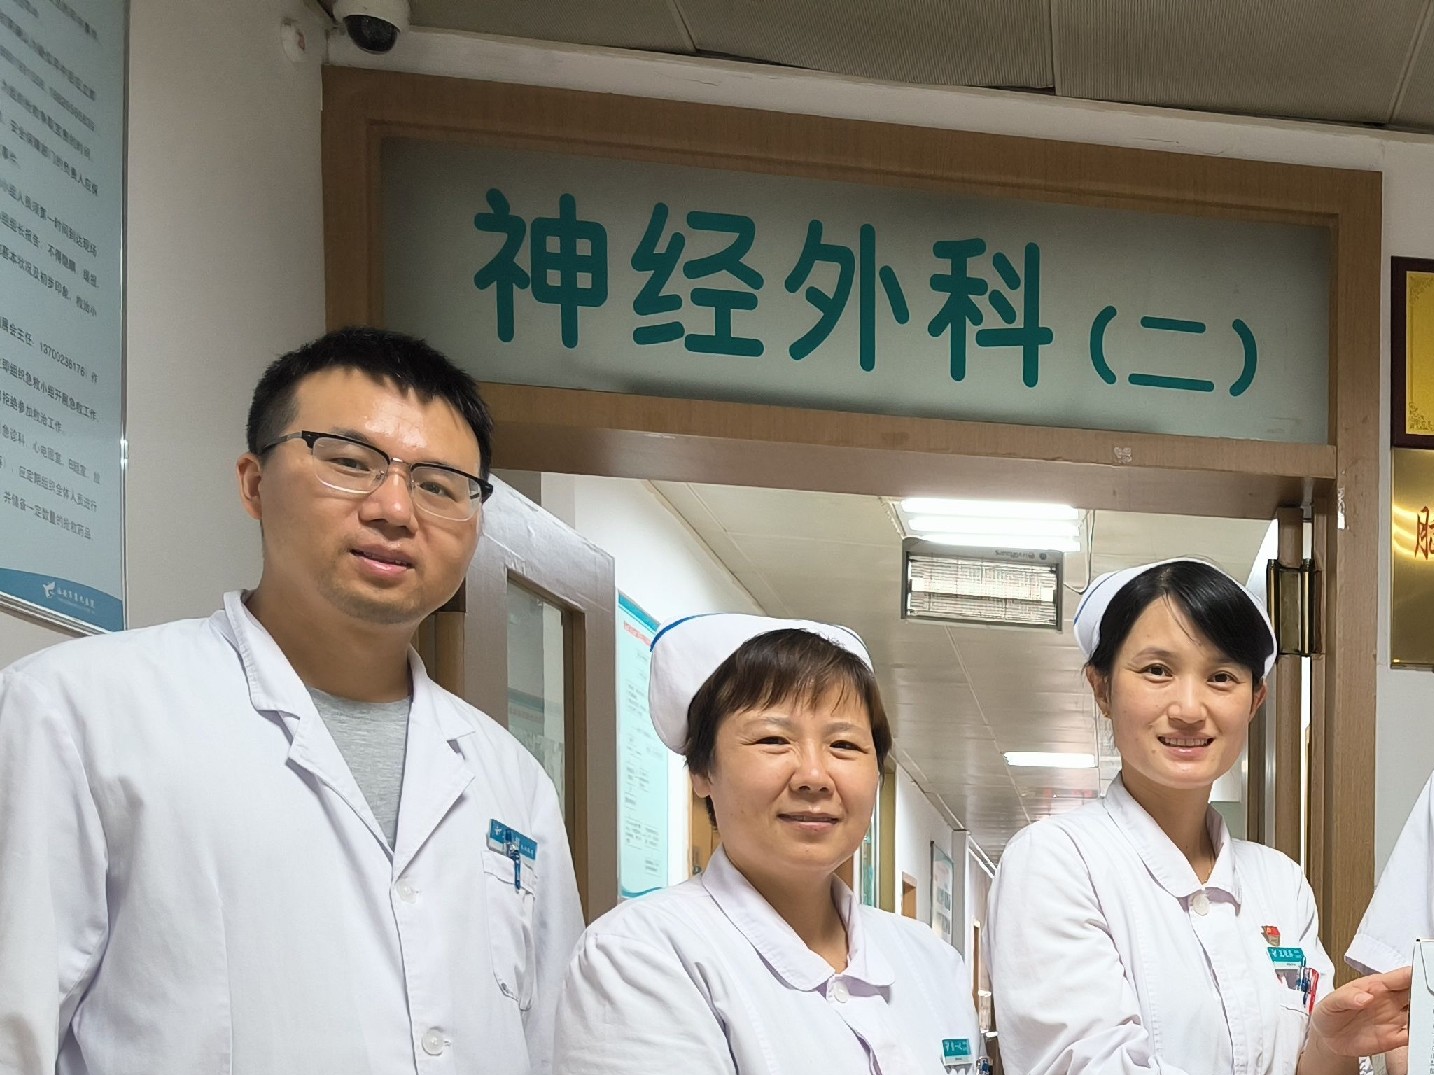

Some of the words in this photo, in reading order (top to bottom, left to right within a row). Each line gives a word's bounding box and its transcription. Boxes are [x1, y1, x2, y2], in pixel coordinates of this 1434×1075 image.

[474, 188, 1258, 397] 神经外科（二）
